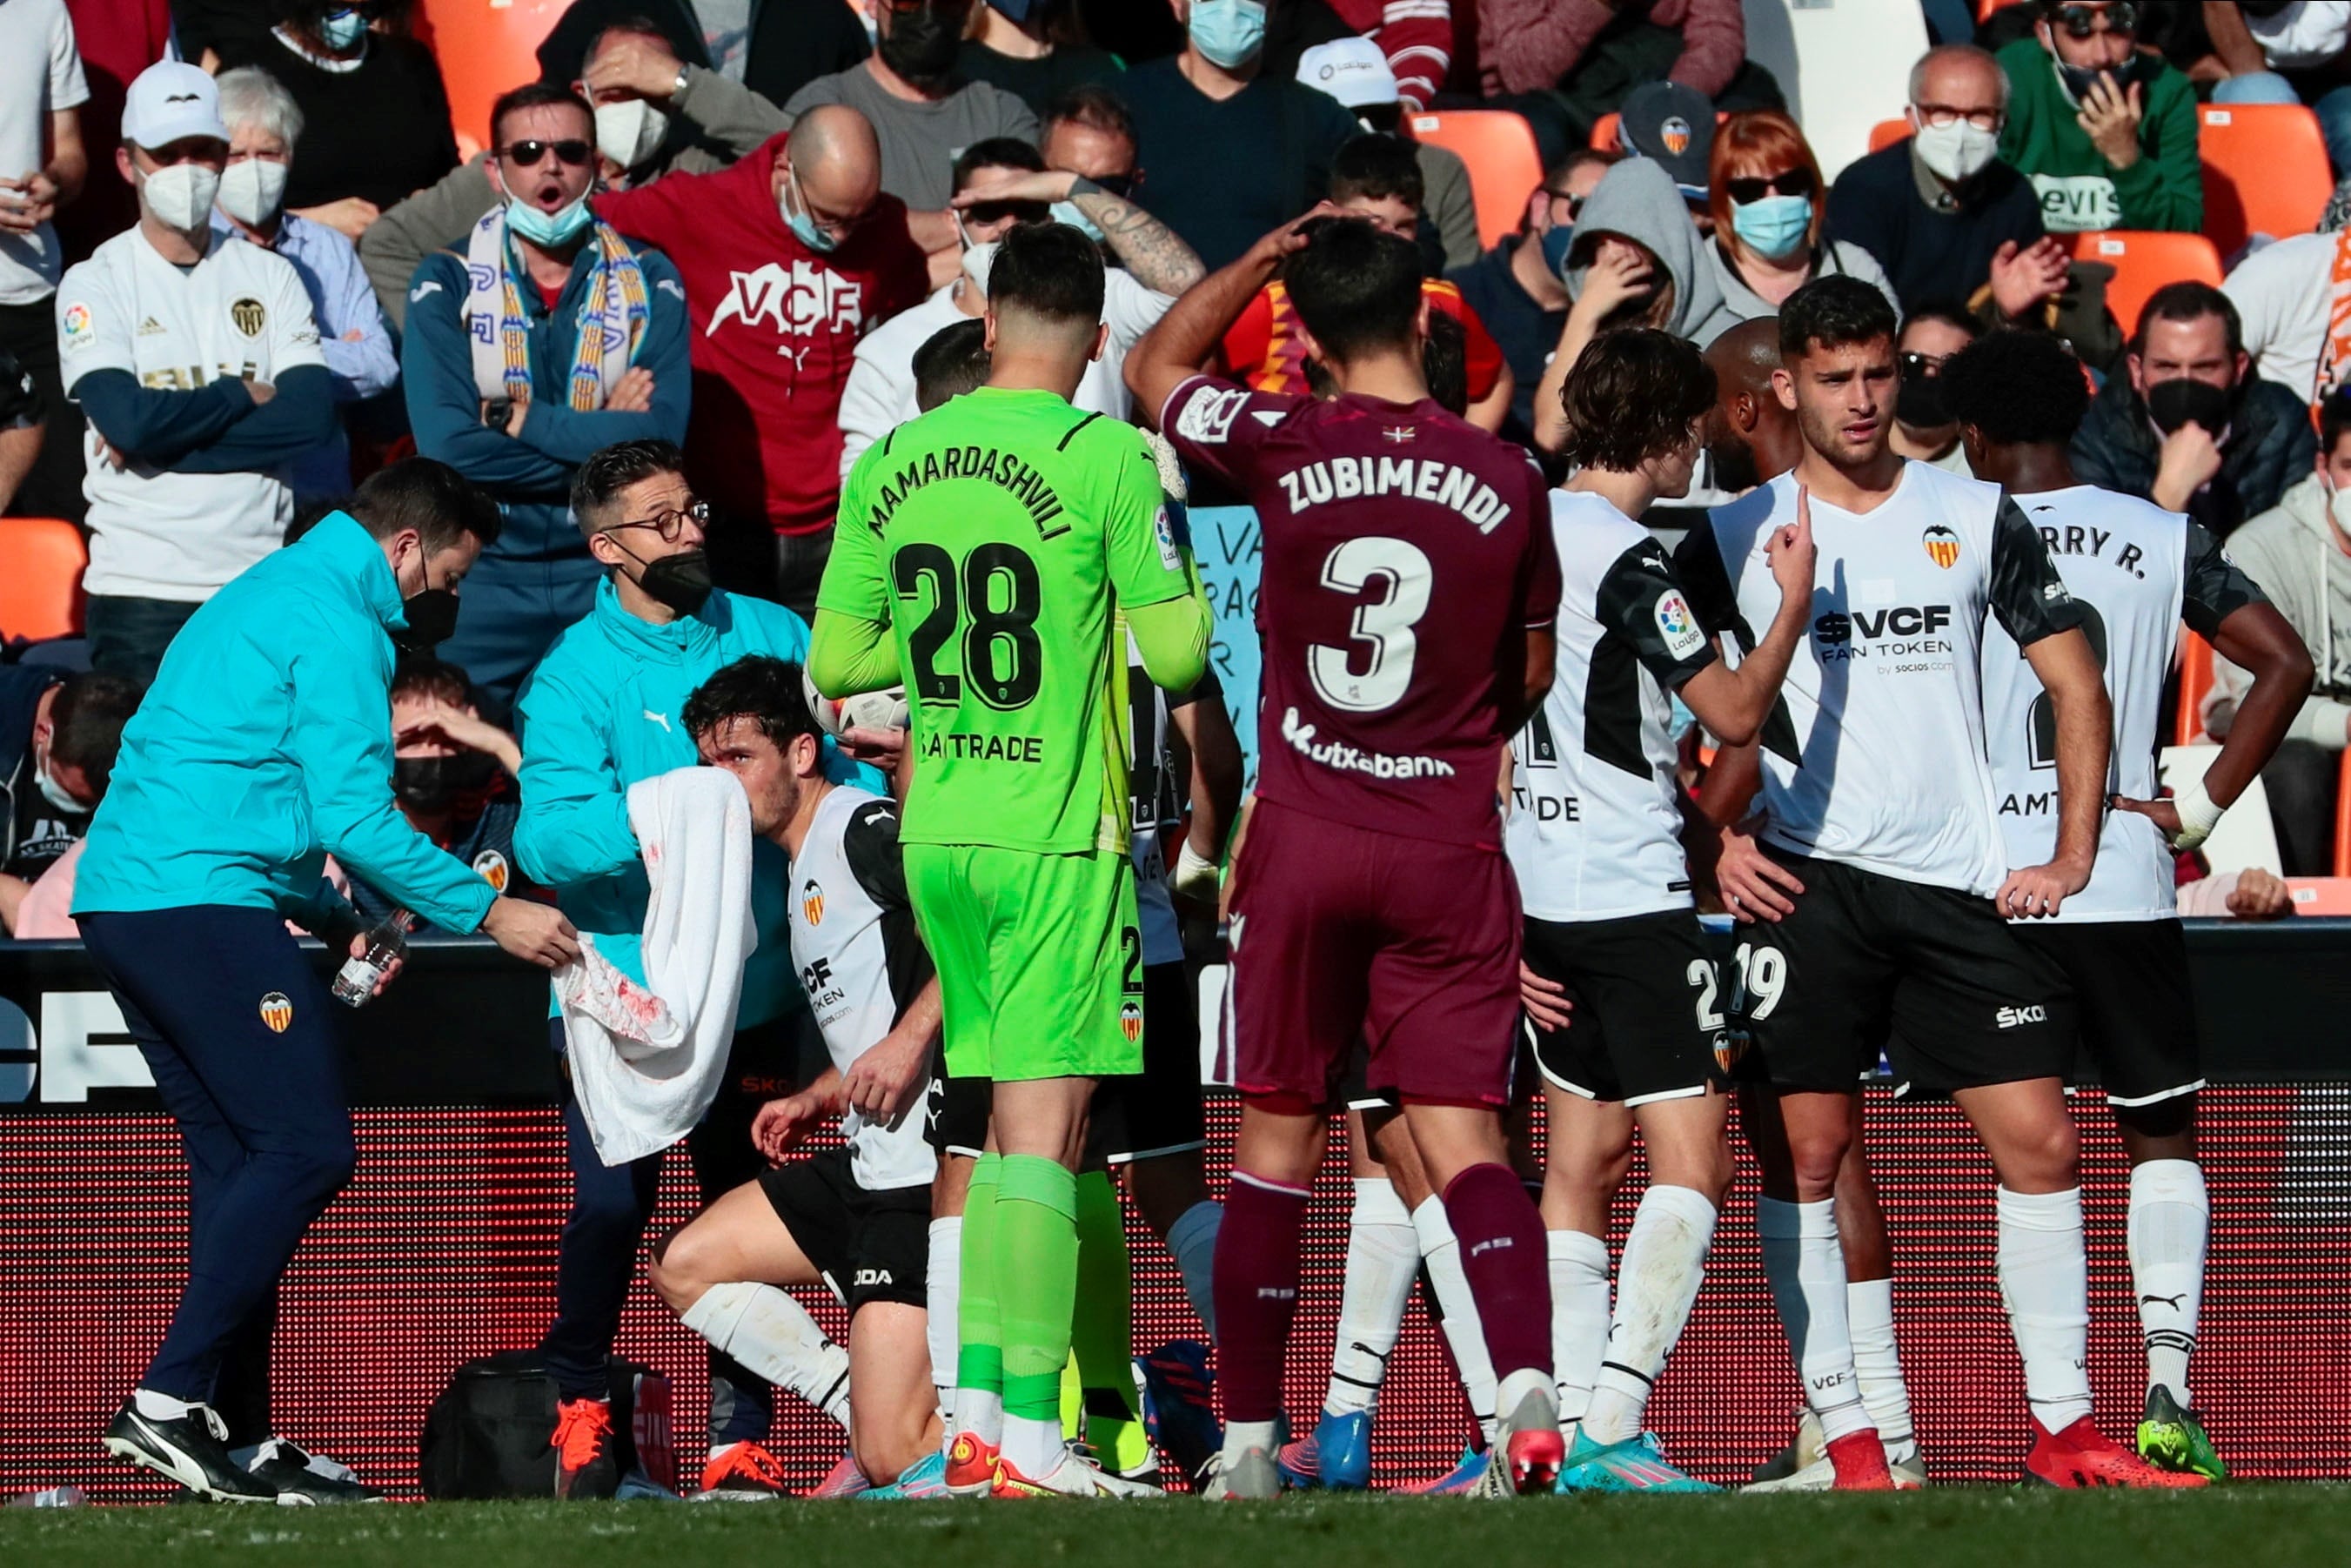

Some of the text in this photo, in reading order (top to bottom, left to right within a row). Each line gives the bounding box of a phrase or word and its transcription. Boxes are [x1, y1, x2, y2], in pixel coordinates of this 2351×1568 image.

[2042, 186, 2120, 215] evi's
[737, 276, 858, 327] VCF
[867, 446, 1072, 542] MAMARDASHVILI
[1278, 456, 1511, 535] ZUBIMENDI
[2038, 525, 2111, 558] RRY
[889, 542, 1043, 712] 28
[1308, 536, 1433, 712] 3
[1814, 605, 1951, 646] $VCF
[1822, 640, 1952, 664] FAN TOKEN
[1996, 1005, 2046, 1029] ŠKO
[1812, 1372, 1845, 1390] VCF
